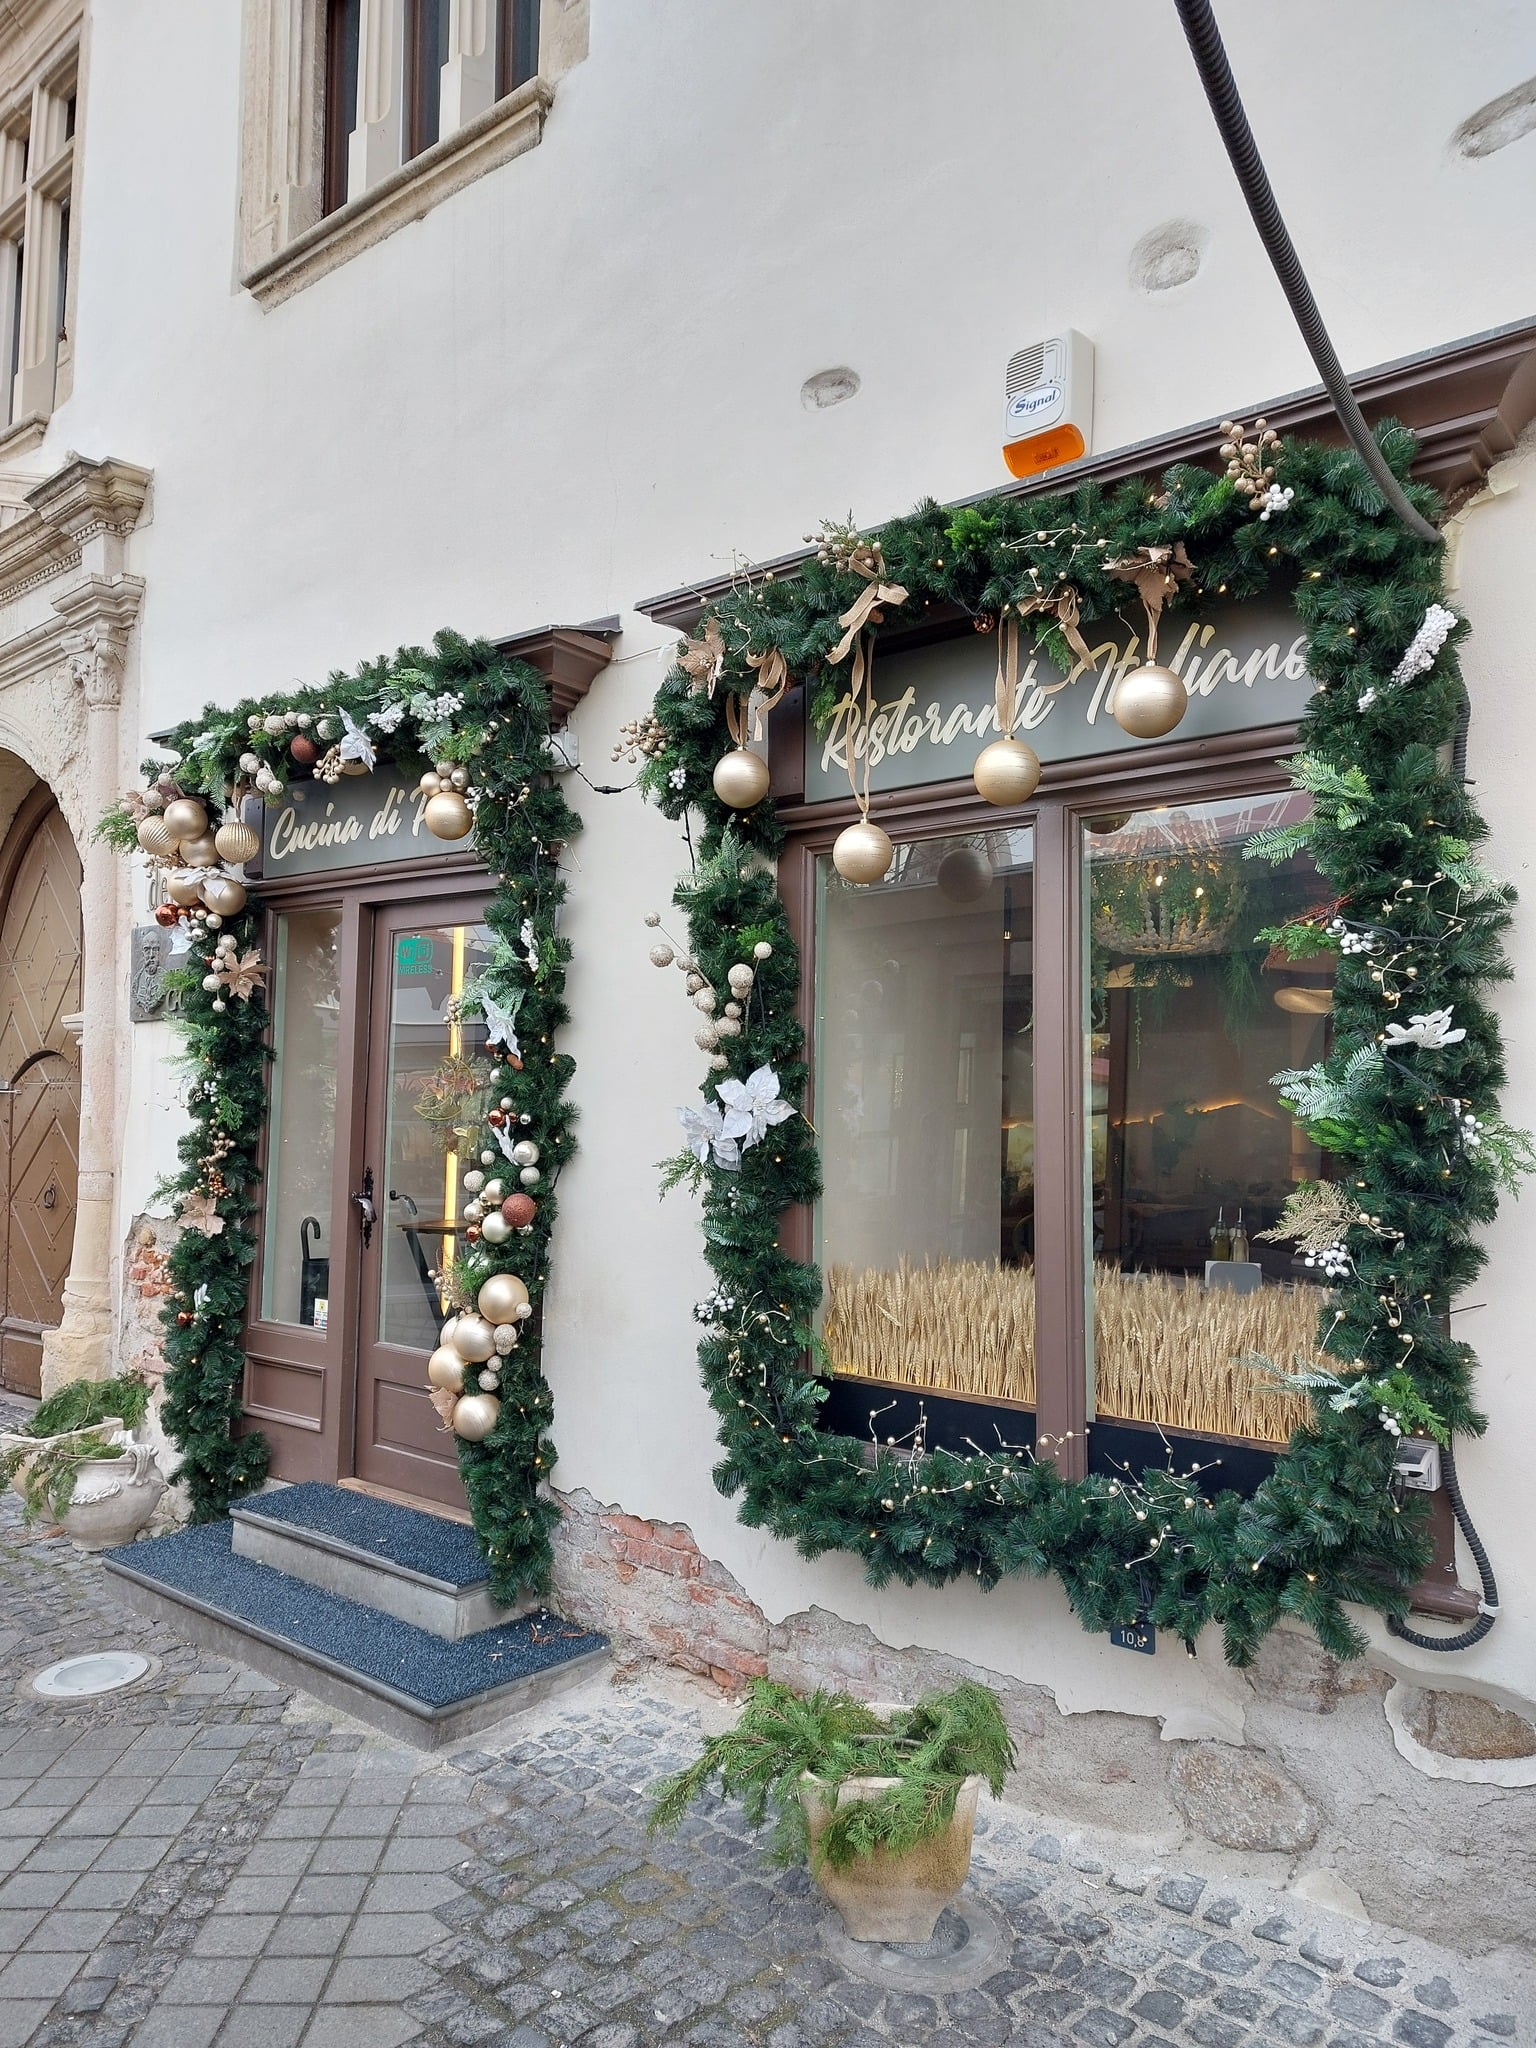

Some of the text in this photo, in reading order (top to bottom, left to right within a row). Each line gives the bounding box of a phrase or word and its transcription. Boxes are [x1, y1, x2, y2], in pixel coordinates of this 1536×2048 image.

[1015, 390, 1056, 413] Signal
[269, 802, 364, 860] Cucina
[369, 787, 405, 840] di
